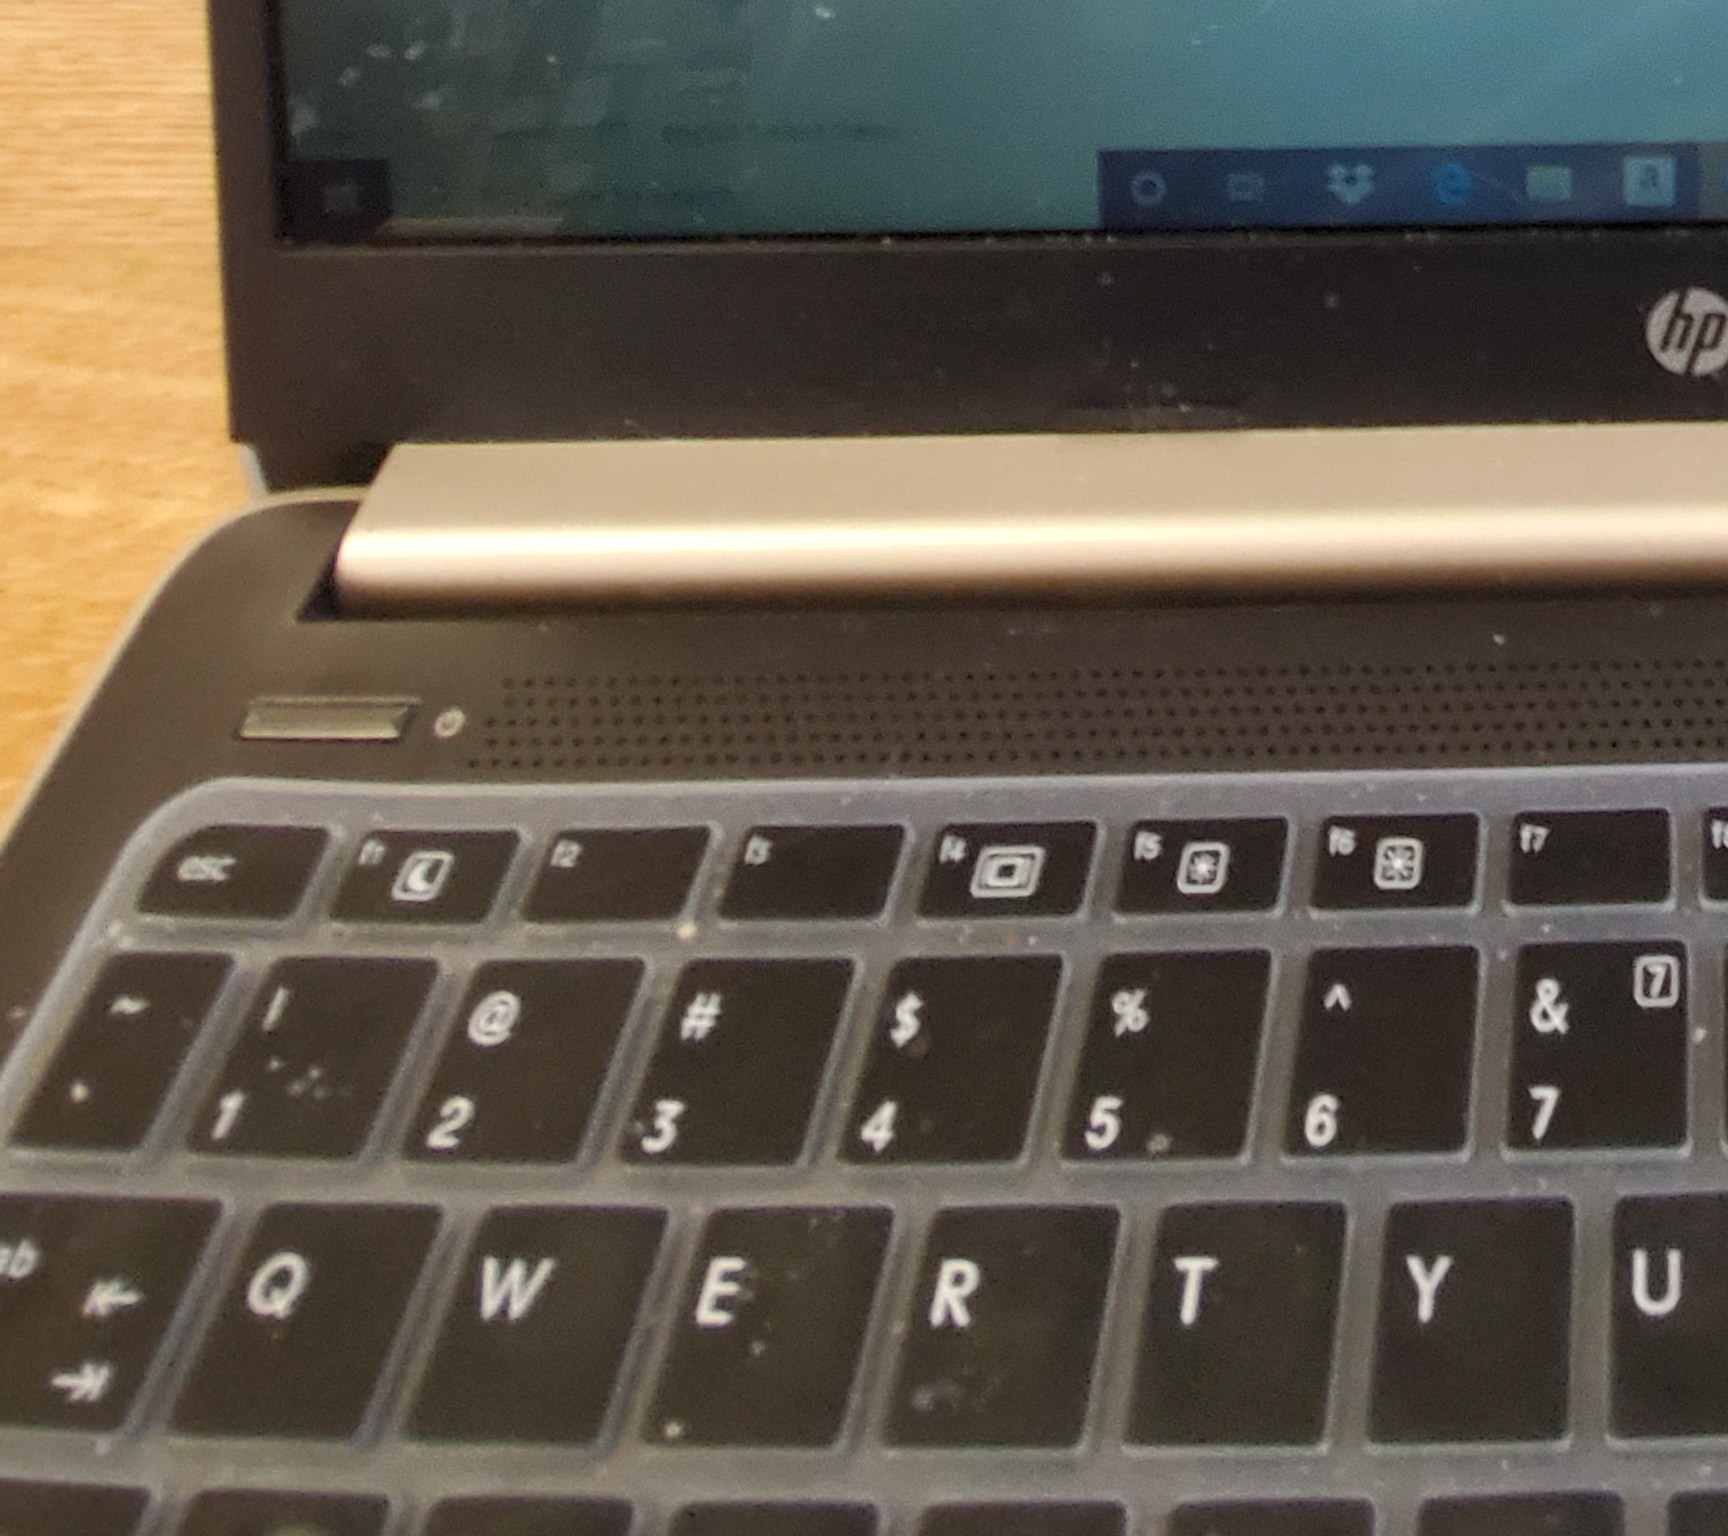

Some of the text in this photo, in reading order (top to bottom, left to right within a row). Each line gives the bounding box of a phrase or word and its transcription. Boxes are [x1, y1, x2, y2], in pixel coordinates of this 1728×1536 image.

[1657, 288, 1727, 376] hp
[175, 851, 237, 884] esc
[211, 1091, 246, 1139] 1
[426, 1097, 478, 1150] 2
[640, 1097, 687, 1154] 3
[859, 1097, 897, 1152] 4
[1084, 1095, 1124, 1150] 5
[1303, 1092, 1340, 1147] 6
[1530, 1086, 1562, 1141] 7
[246, 1250, 310, 1320] Q
[479, 1256, 556, 1323] W
[694, 1255, 748, 1326] E
[928, 1257, 983, 1329] R
[1172, 1255, 1220, 1326] T
[1405, 1254, 1454, 1324] Y
[1631, 1248, 1683, 1318] U
